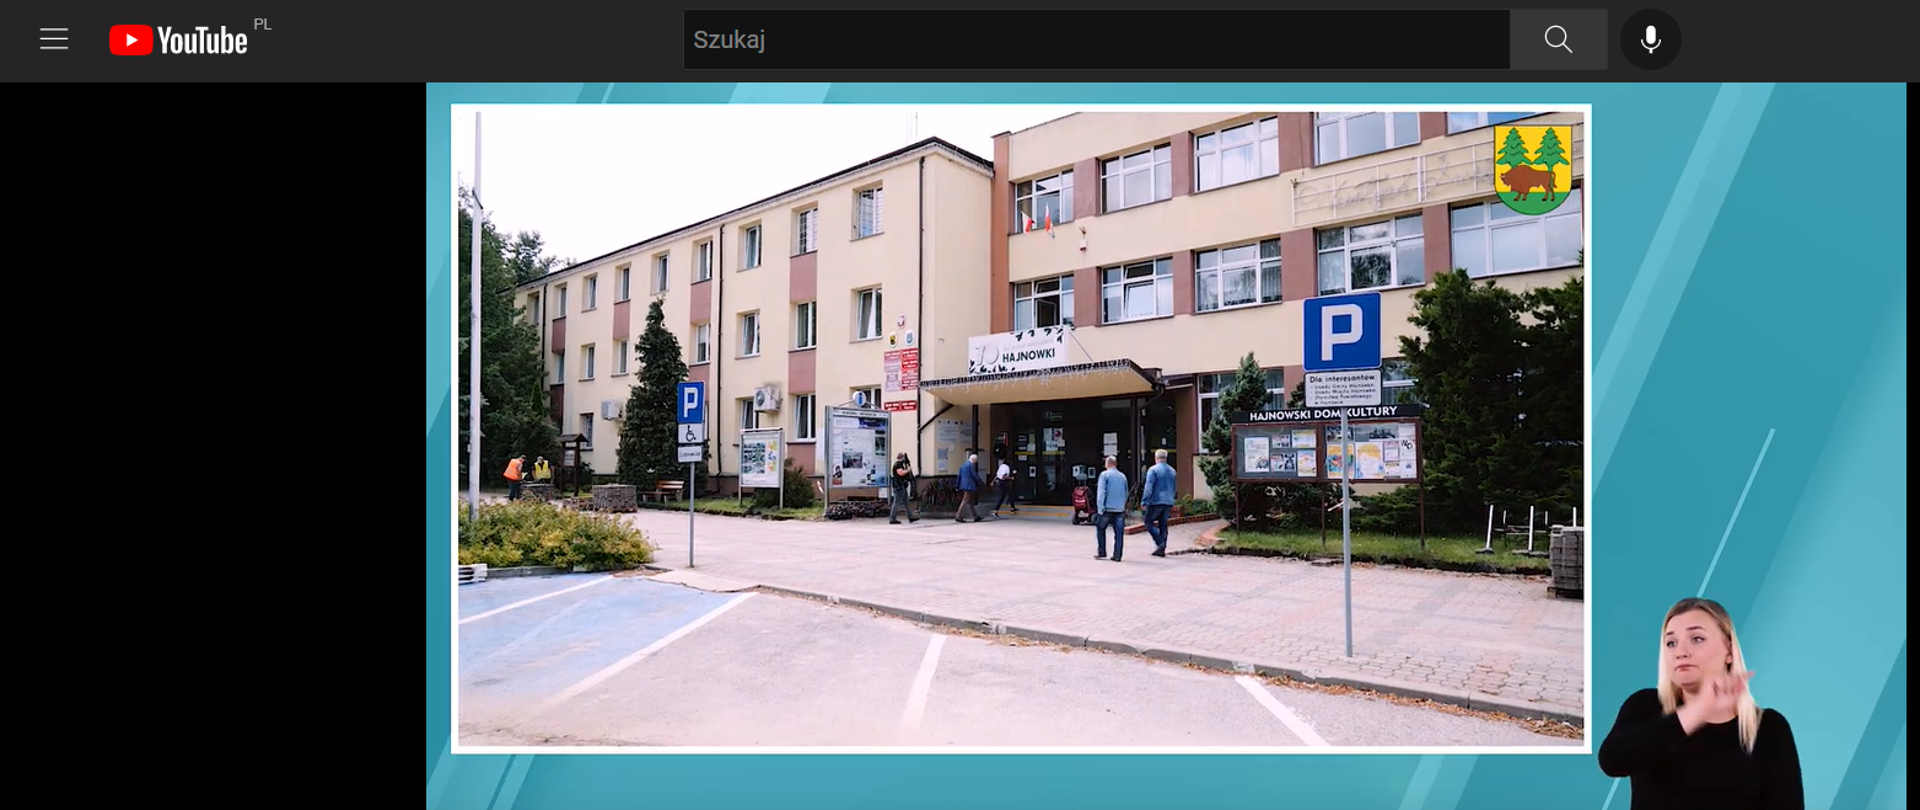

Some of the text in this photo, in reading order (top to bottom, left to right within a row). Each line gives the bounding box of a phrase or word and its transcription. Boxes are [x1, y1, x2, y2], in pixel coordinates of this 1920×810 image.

[1321, 304, 1363, 361] P
[684, 387, 699, 418] P
[1250, 410, 1311, 421] HAJNOWSKI
[1314, 408, 1341, 419] DOM
